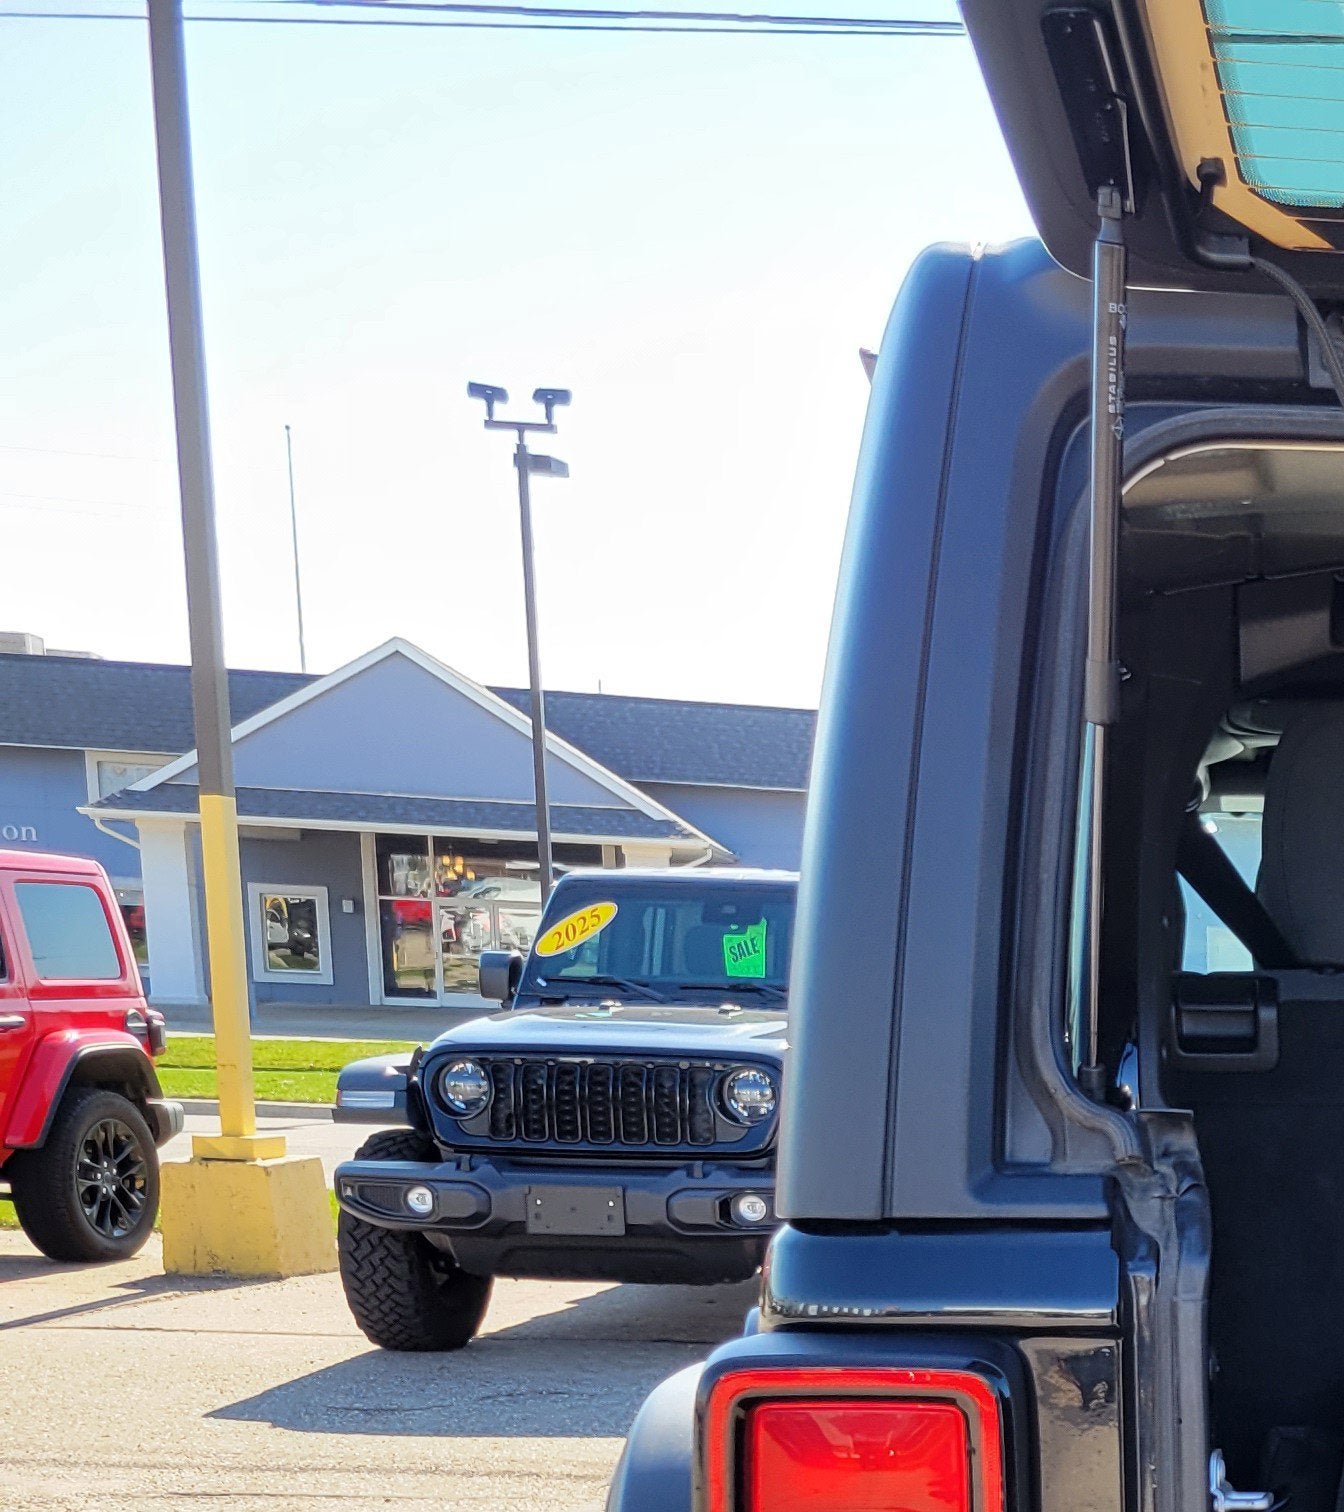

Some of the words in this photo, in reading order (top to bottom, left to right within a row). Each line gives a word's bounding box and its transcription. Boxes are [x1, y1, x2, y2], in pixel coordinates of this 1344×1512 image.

[1108, 336, 1117, 414] STABILUS
[552, 907, 602, 951] 2025
[728, 936, 760, 964] SALE
